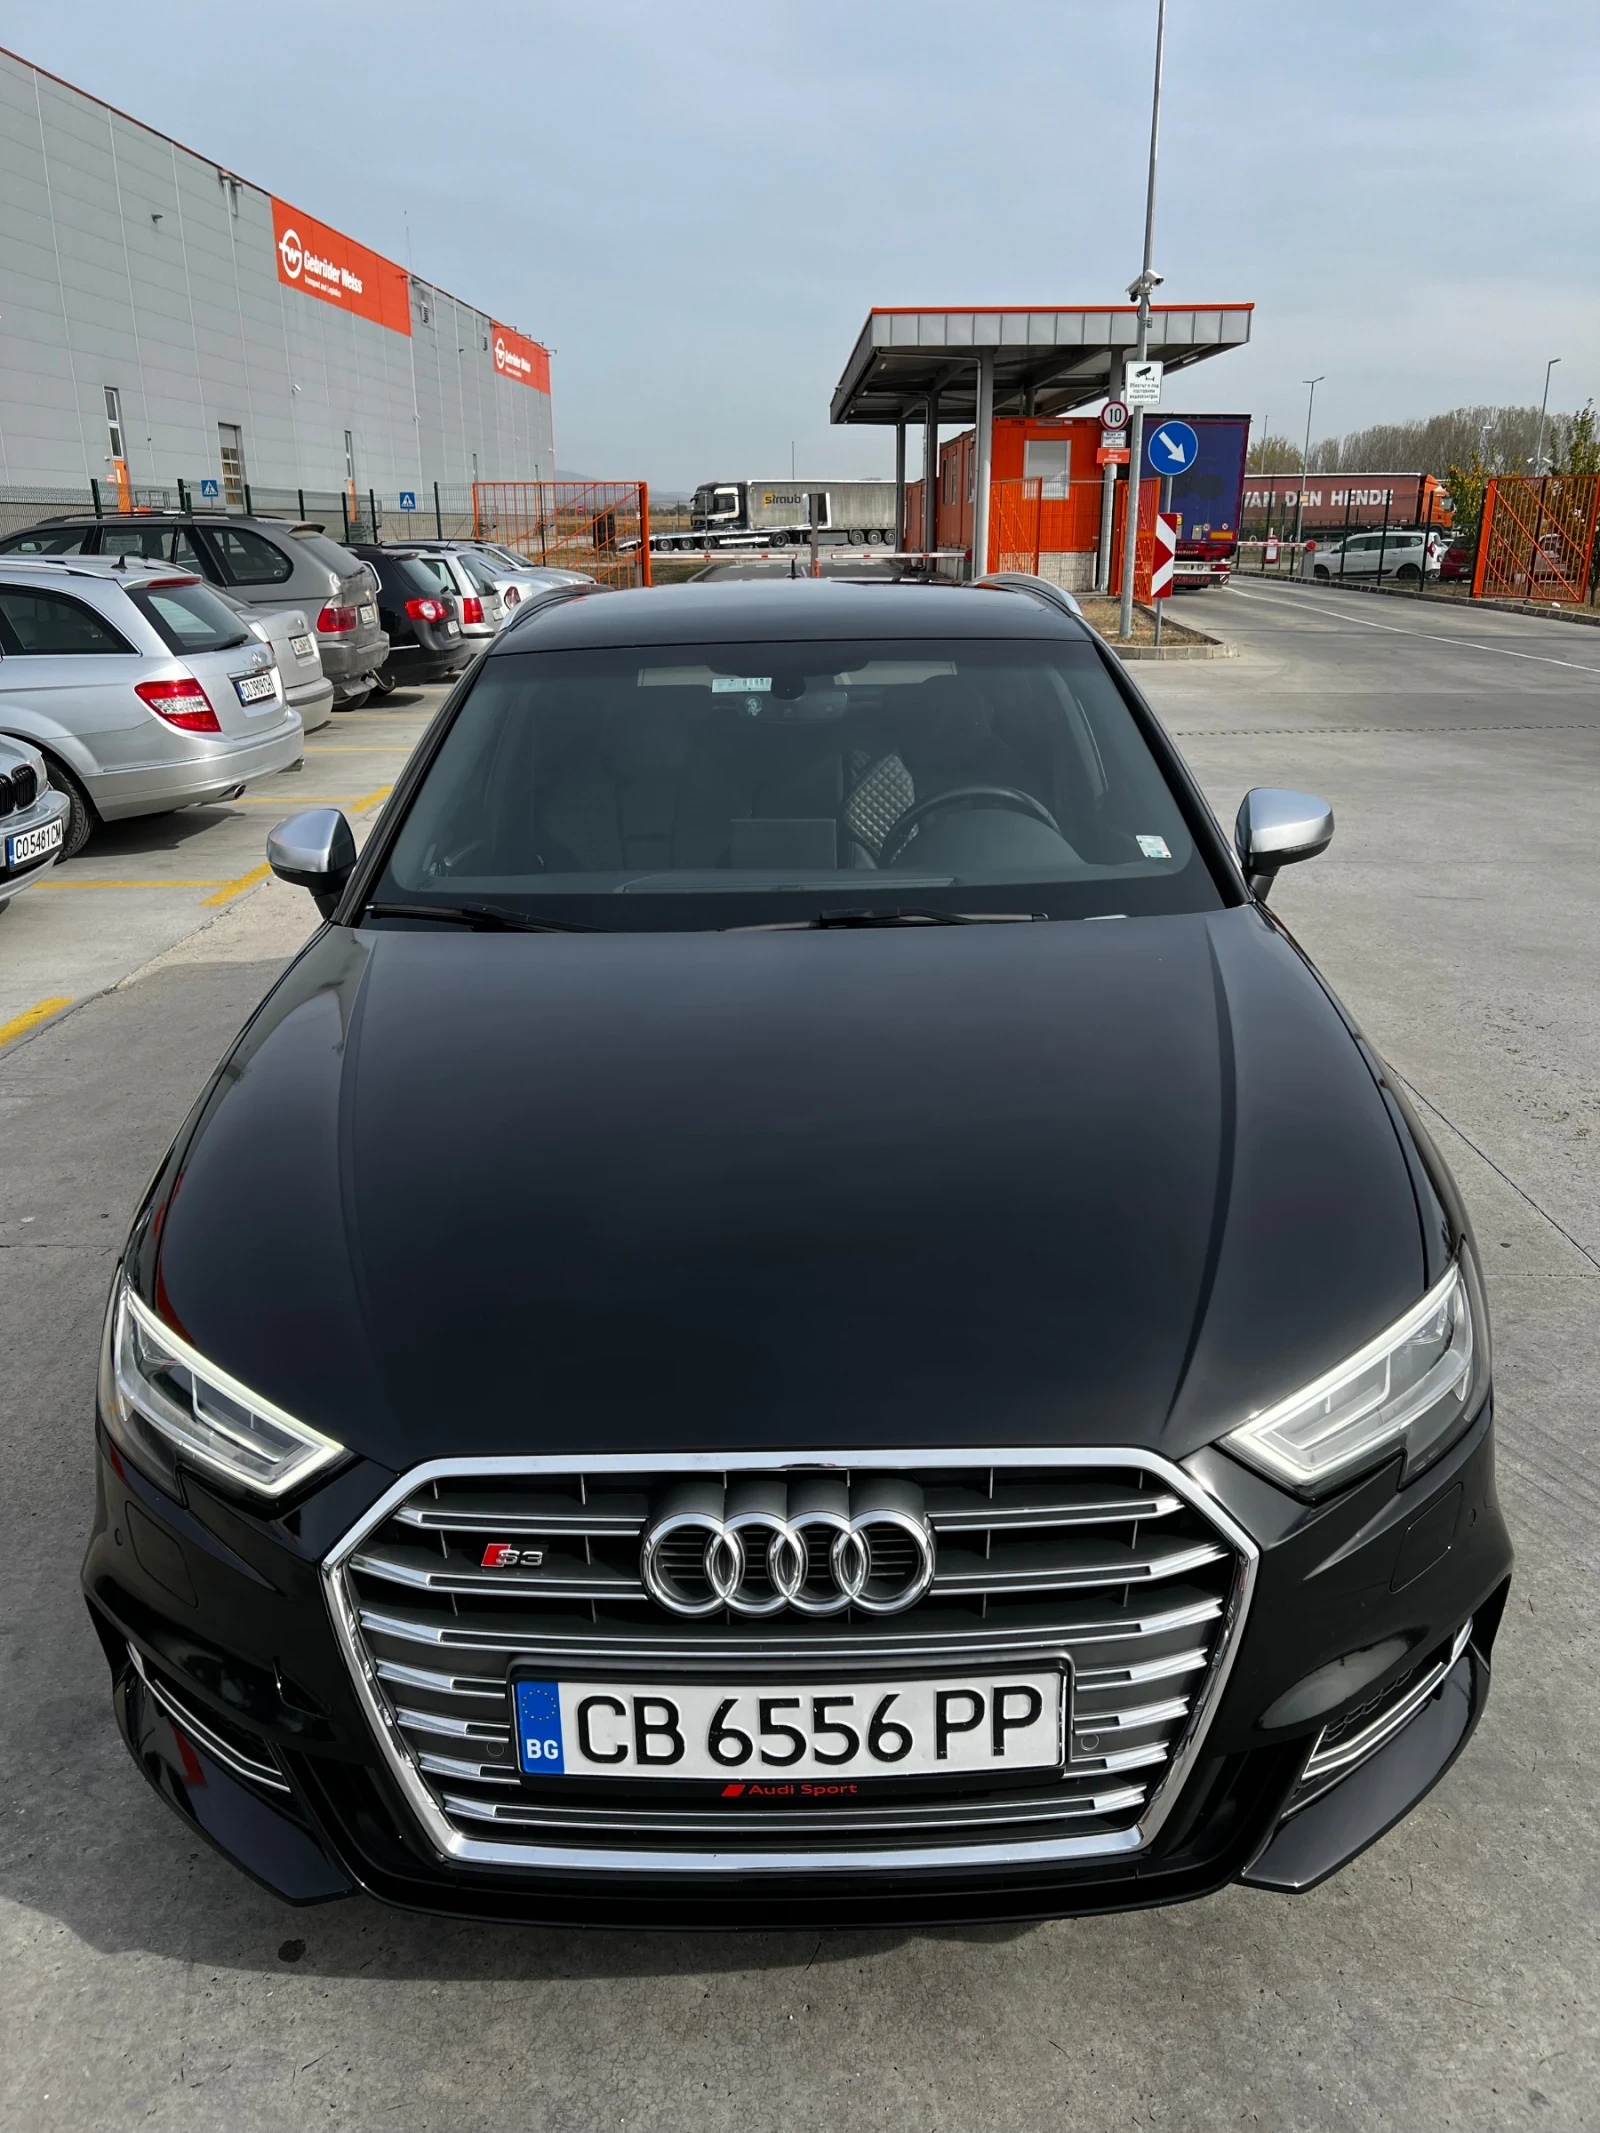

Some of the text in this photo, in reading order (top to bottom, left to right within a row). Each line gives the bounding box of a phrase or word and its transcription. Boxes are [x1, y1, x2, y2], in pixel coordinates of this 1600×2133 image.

[304, 250, 362, 294] Gebrüder Weiss
[1109, 408, 1122, 423] 10
[765, 493, 801, 504] straub
[1284, 490, 1322, 507] DEN
[1330, 489, 1394, 507] HENDE
[496, 1549, 543, 1566] S3
[577, 1685, 1043, 1767] CB 6556 PP
[526, 1738, 559, 1760] BG
[750, 1784, 858, 1796] Audi Sport
